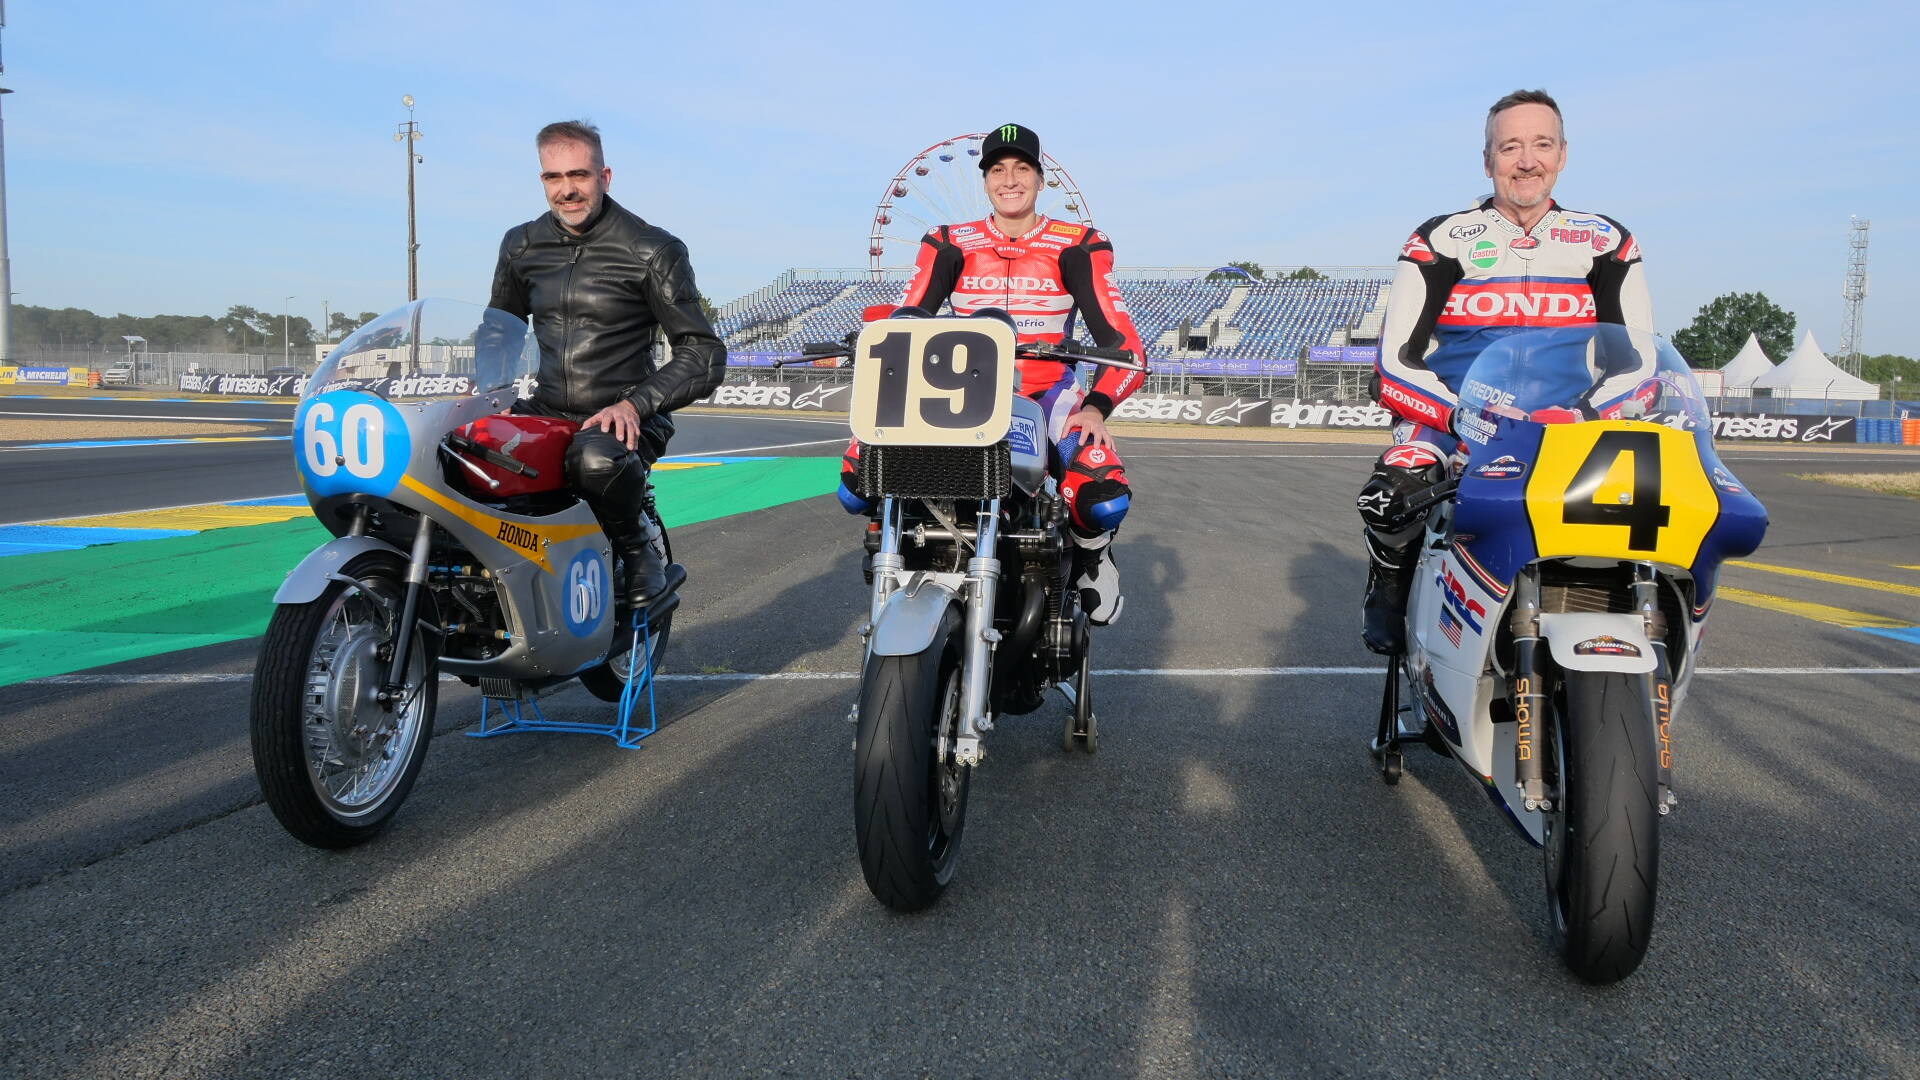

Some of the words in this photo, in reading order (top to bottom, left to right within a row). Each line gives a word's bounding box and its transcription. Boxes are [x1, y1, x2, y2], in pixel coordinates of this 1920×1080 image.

[985, 217, 1004, 240] ONDA
[1453, 224, 1483, 237] Arai
[1550, 228, 1610, 252] FREDIE
[1472, 249, 1498, 259] Castrol
[962, 276, 1060, 291] HONDA
[1440, 292, 1597, 318] HONDA
[26, 371, 68, 380] MICHELIN
[218, 373, 269, 395] alpinestars
[389, 372, 469, 398] alpinestars
[868, 331, 999, 430] 19
[1382, 383, 1439, 419] HONDA
[1467, 379, 1517, 409] FREDDIE
[1462, 407, 1498, 437] Rothmans
[304, 402, 384, 479] 60
[1460, 425, 1490, 446] HONDA
[1562, 430, 1671, 552] 4
[496, 521, 540, 553] HONDA
[570, 558, 601, 624] 60
